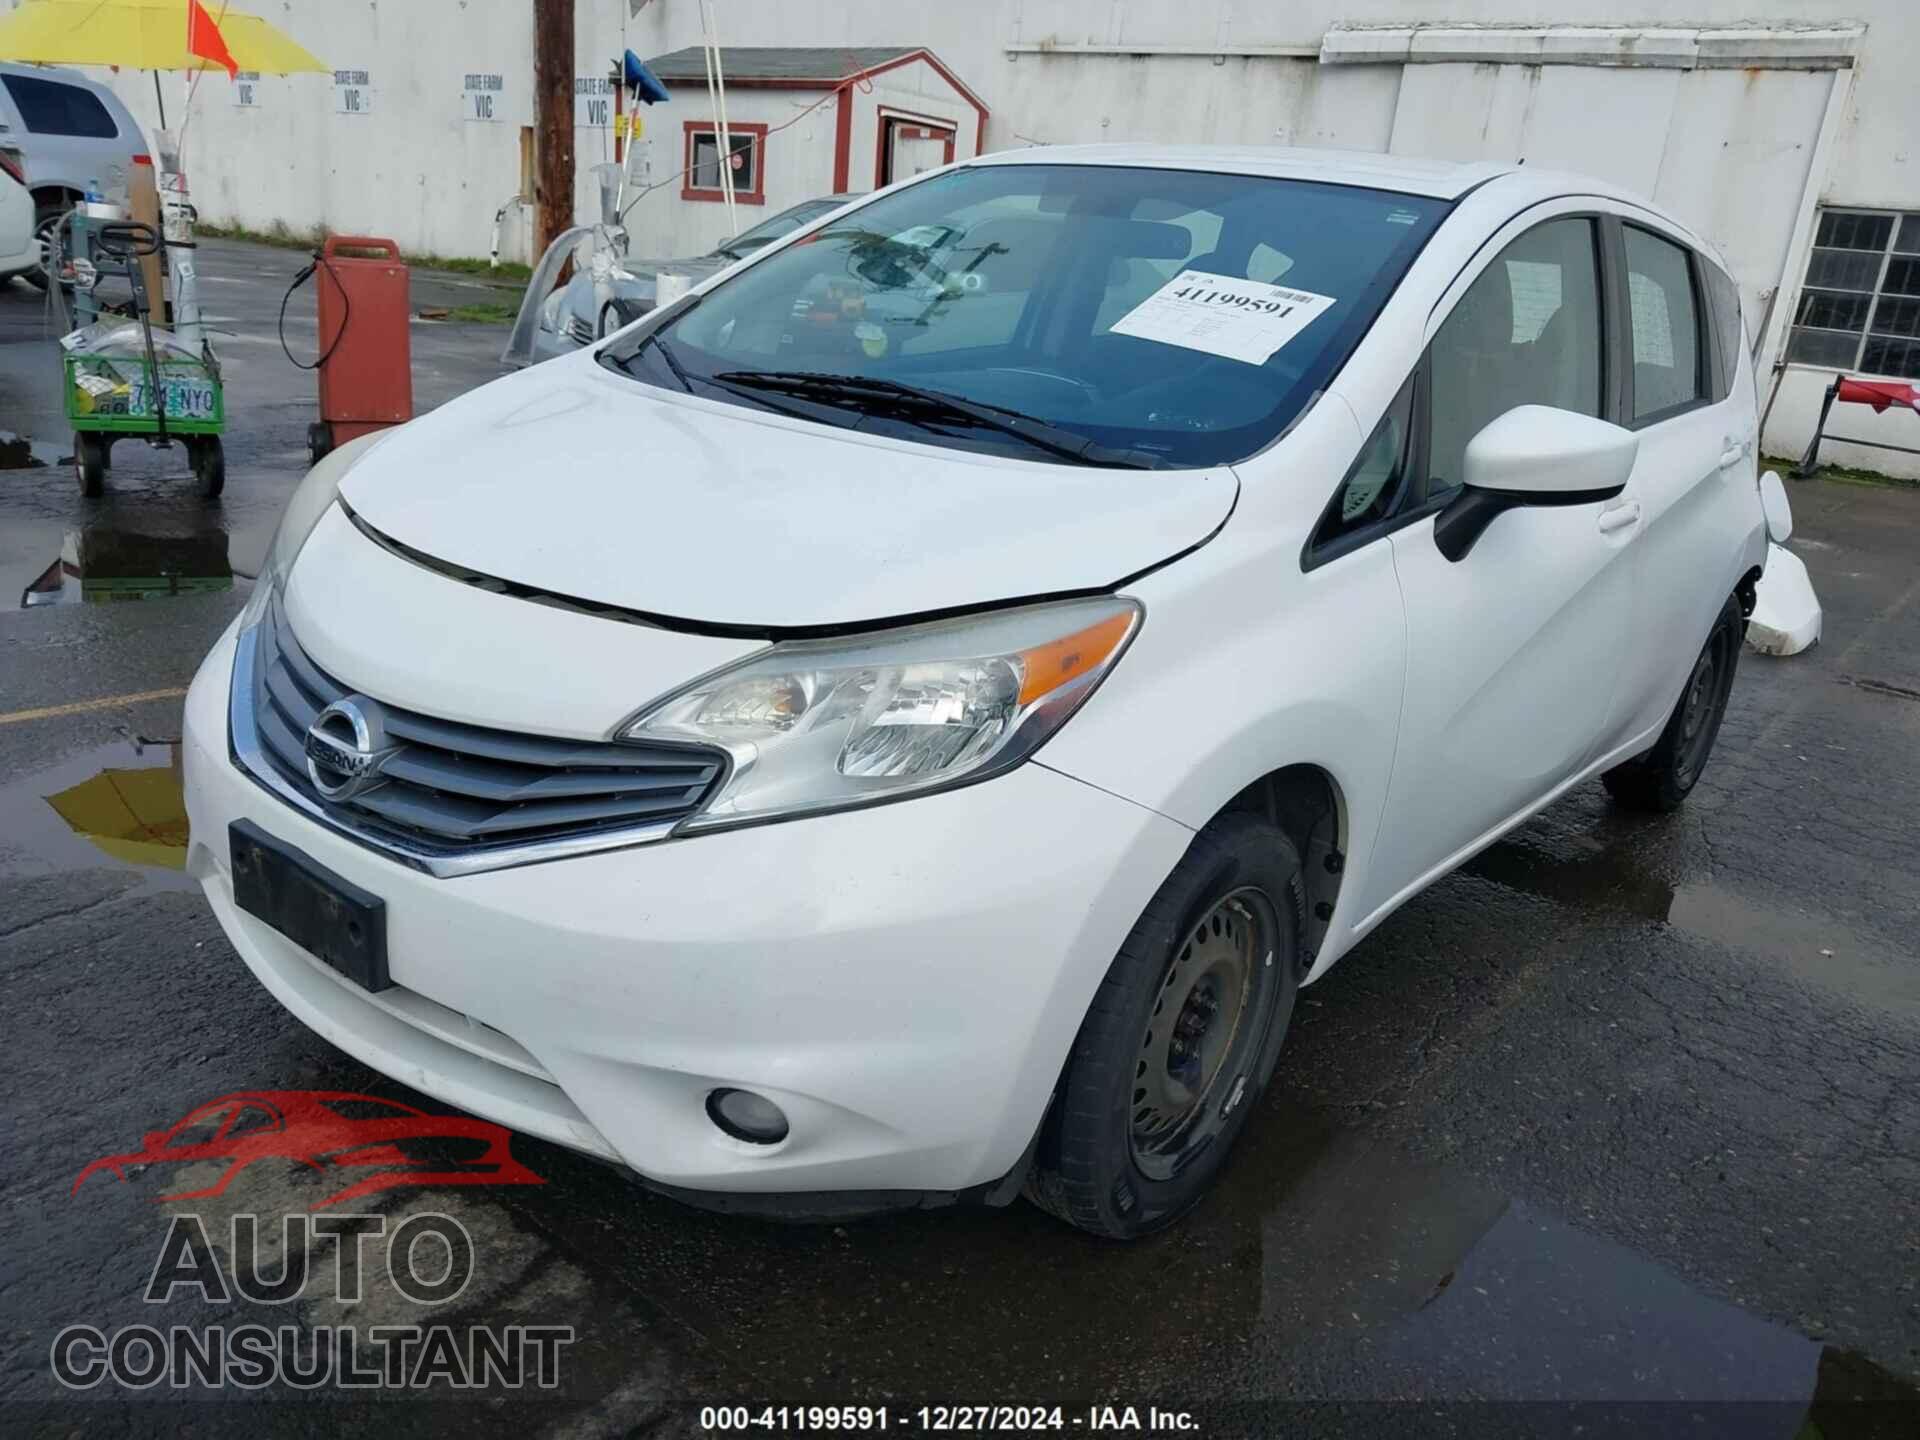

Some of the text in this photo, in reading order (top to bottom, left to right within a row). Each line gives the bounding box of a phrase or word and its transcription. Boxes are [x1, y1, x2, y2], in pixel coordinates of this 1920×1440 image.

[464, 74, 503, 90] STATE FARM
[575, 77, 597, 95] STATE
[344, 89, 360, 111] VIC
[474, 95, 492, 118] VIC
[587, 99, 607, 124] VIC
[1173, 286, 1294, 319] 41199591
